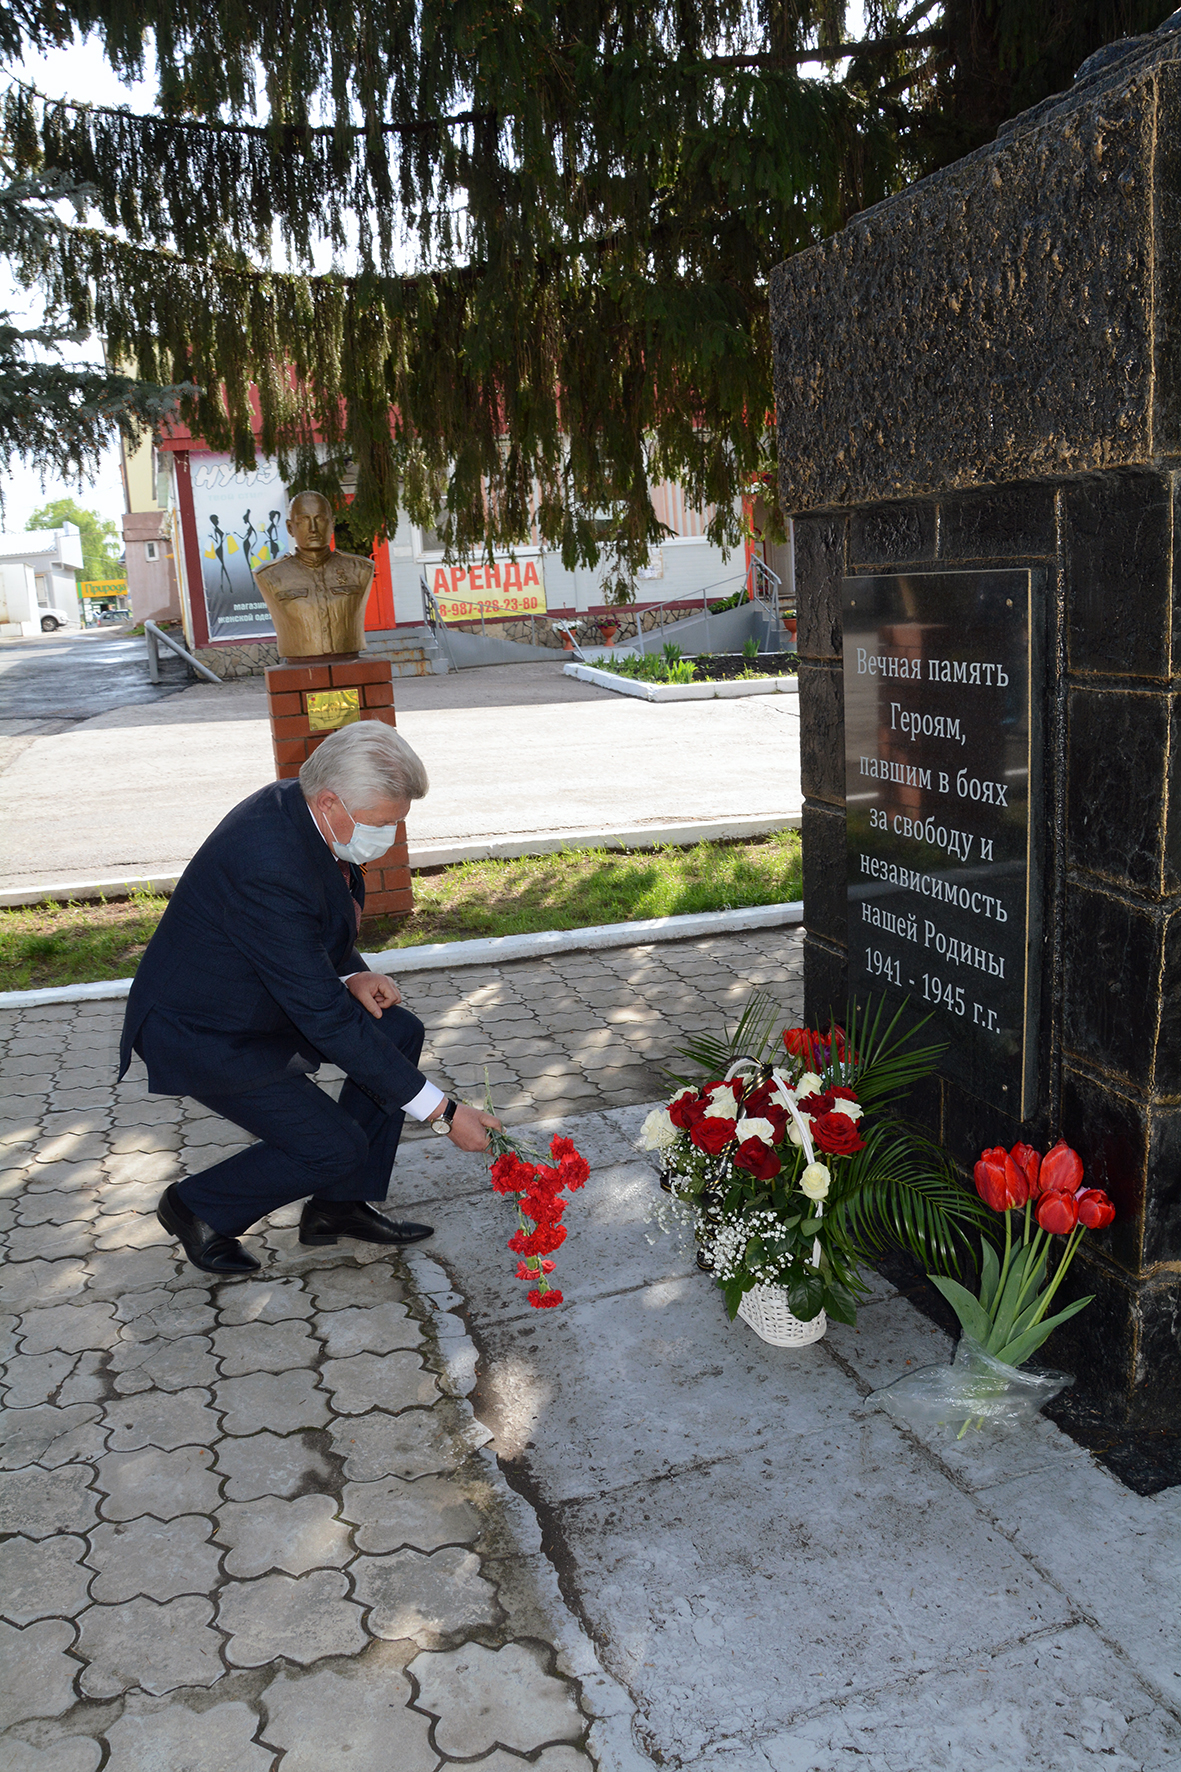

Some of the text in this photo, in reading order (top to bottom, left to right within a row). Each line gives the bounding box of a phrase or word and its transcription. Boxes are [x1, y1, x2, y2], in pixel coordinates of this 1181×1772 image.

[85, 583, 127, 595] Природа
[433, 561, 540, 594] АРЕНДА
[217, 613, 254, 624] женской
[439, 597, 538, 618] 8-987-328-23-80
[856, 647, 1010, 687] Вечная память
[890, 702, 966, 746] Героям,
[859, 756, 1009, 807] павшим в боях
[869, 808, 994, 862] за свободу и
[859, 853, 1008, 923] независимость
[861, 902, 1005, 979] нашей Родины
[865, 946, 902, 987] 1941
[922, 973, 966, 1016] 1945
[972, 1002, 1000, 1034] г.г.
